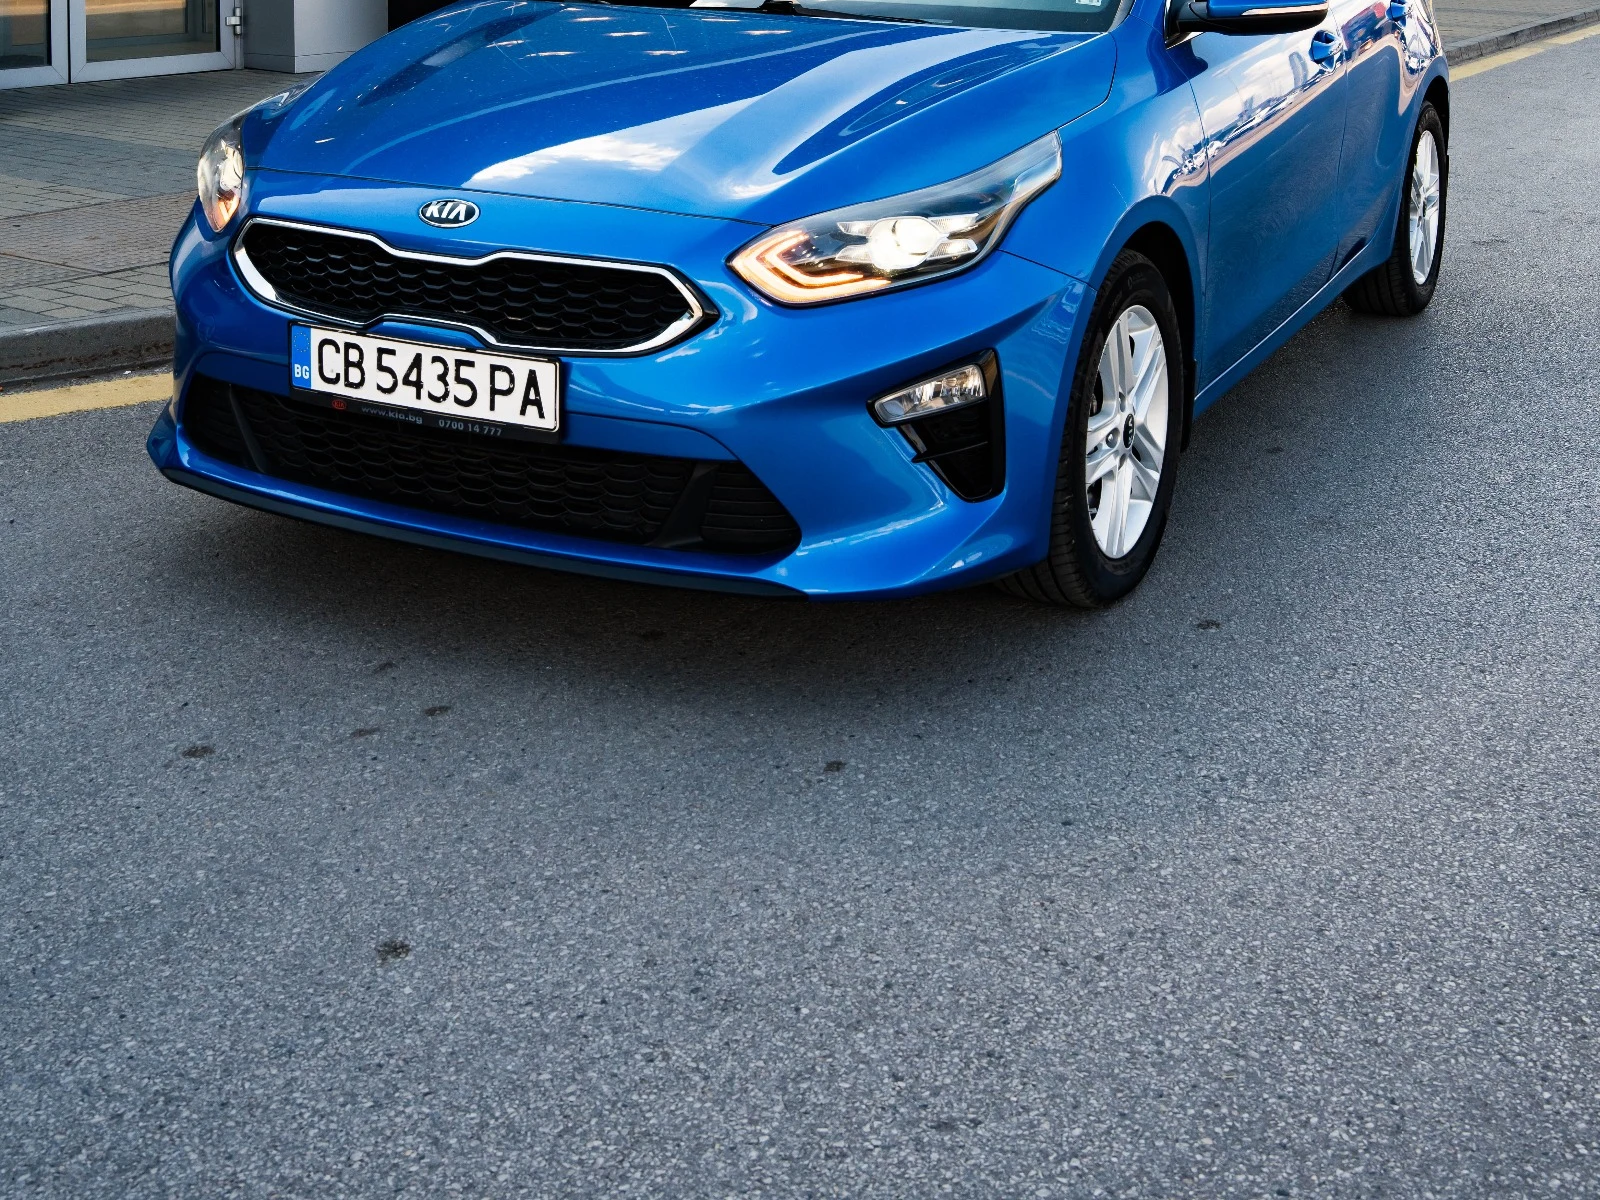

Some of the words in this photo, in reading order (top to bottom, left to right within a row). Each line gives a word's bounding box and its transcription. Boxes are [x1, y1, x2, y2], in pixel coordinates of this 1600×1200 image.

[425, 200, 468, 222] KIA
[293, 363, 310, 379] BG
[317, 338, 366, 389] CB
[376, 346, 478, 408] 5435
[489, 363, 546, 420] PA
[361, 406, 423, 424] www.kia.bg
[438, 419, 464, 431] 0700
[467, 423, 480, 433] 14
[483, 425, 502, 436] 777
